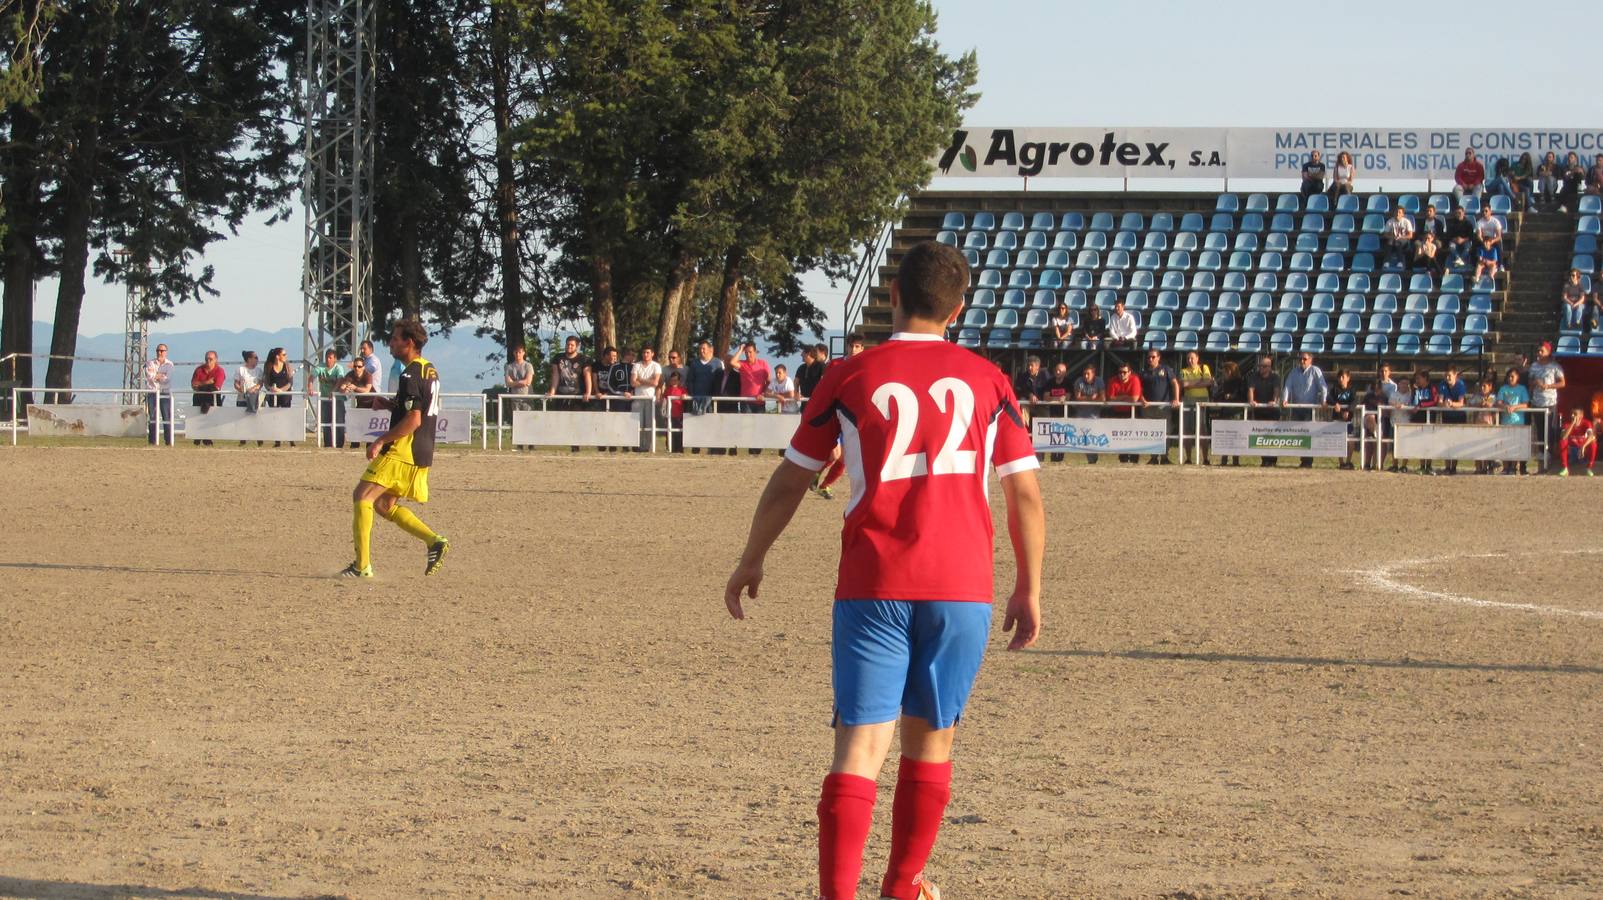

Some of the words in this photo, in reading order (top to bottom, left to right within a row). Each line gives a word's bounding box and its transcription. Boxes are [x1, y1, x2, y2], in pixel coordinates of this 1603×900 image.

[1275, 132, 1418, 149] MATERIALES
[1431, 132, 1460, 149] DE
[983, 129, 1176, 176] Agrotex,
[1189, 150, 1227, 166] S.A.
[1275, 153, 1391, 171] PROETOS,
[871, 377, 977, 482] 22
[1256, 436, 1302, 448] Europcar
